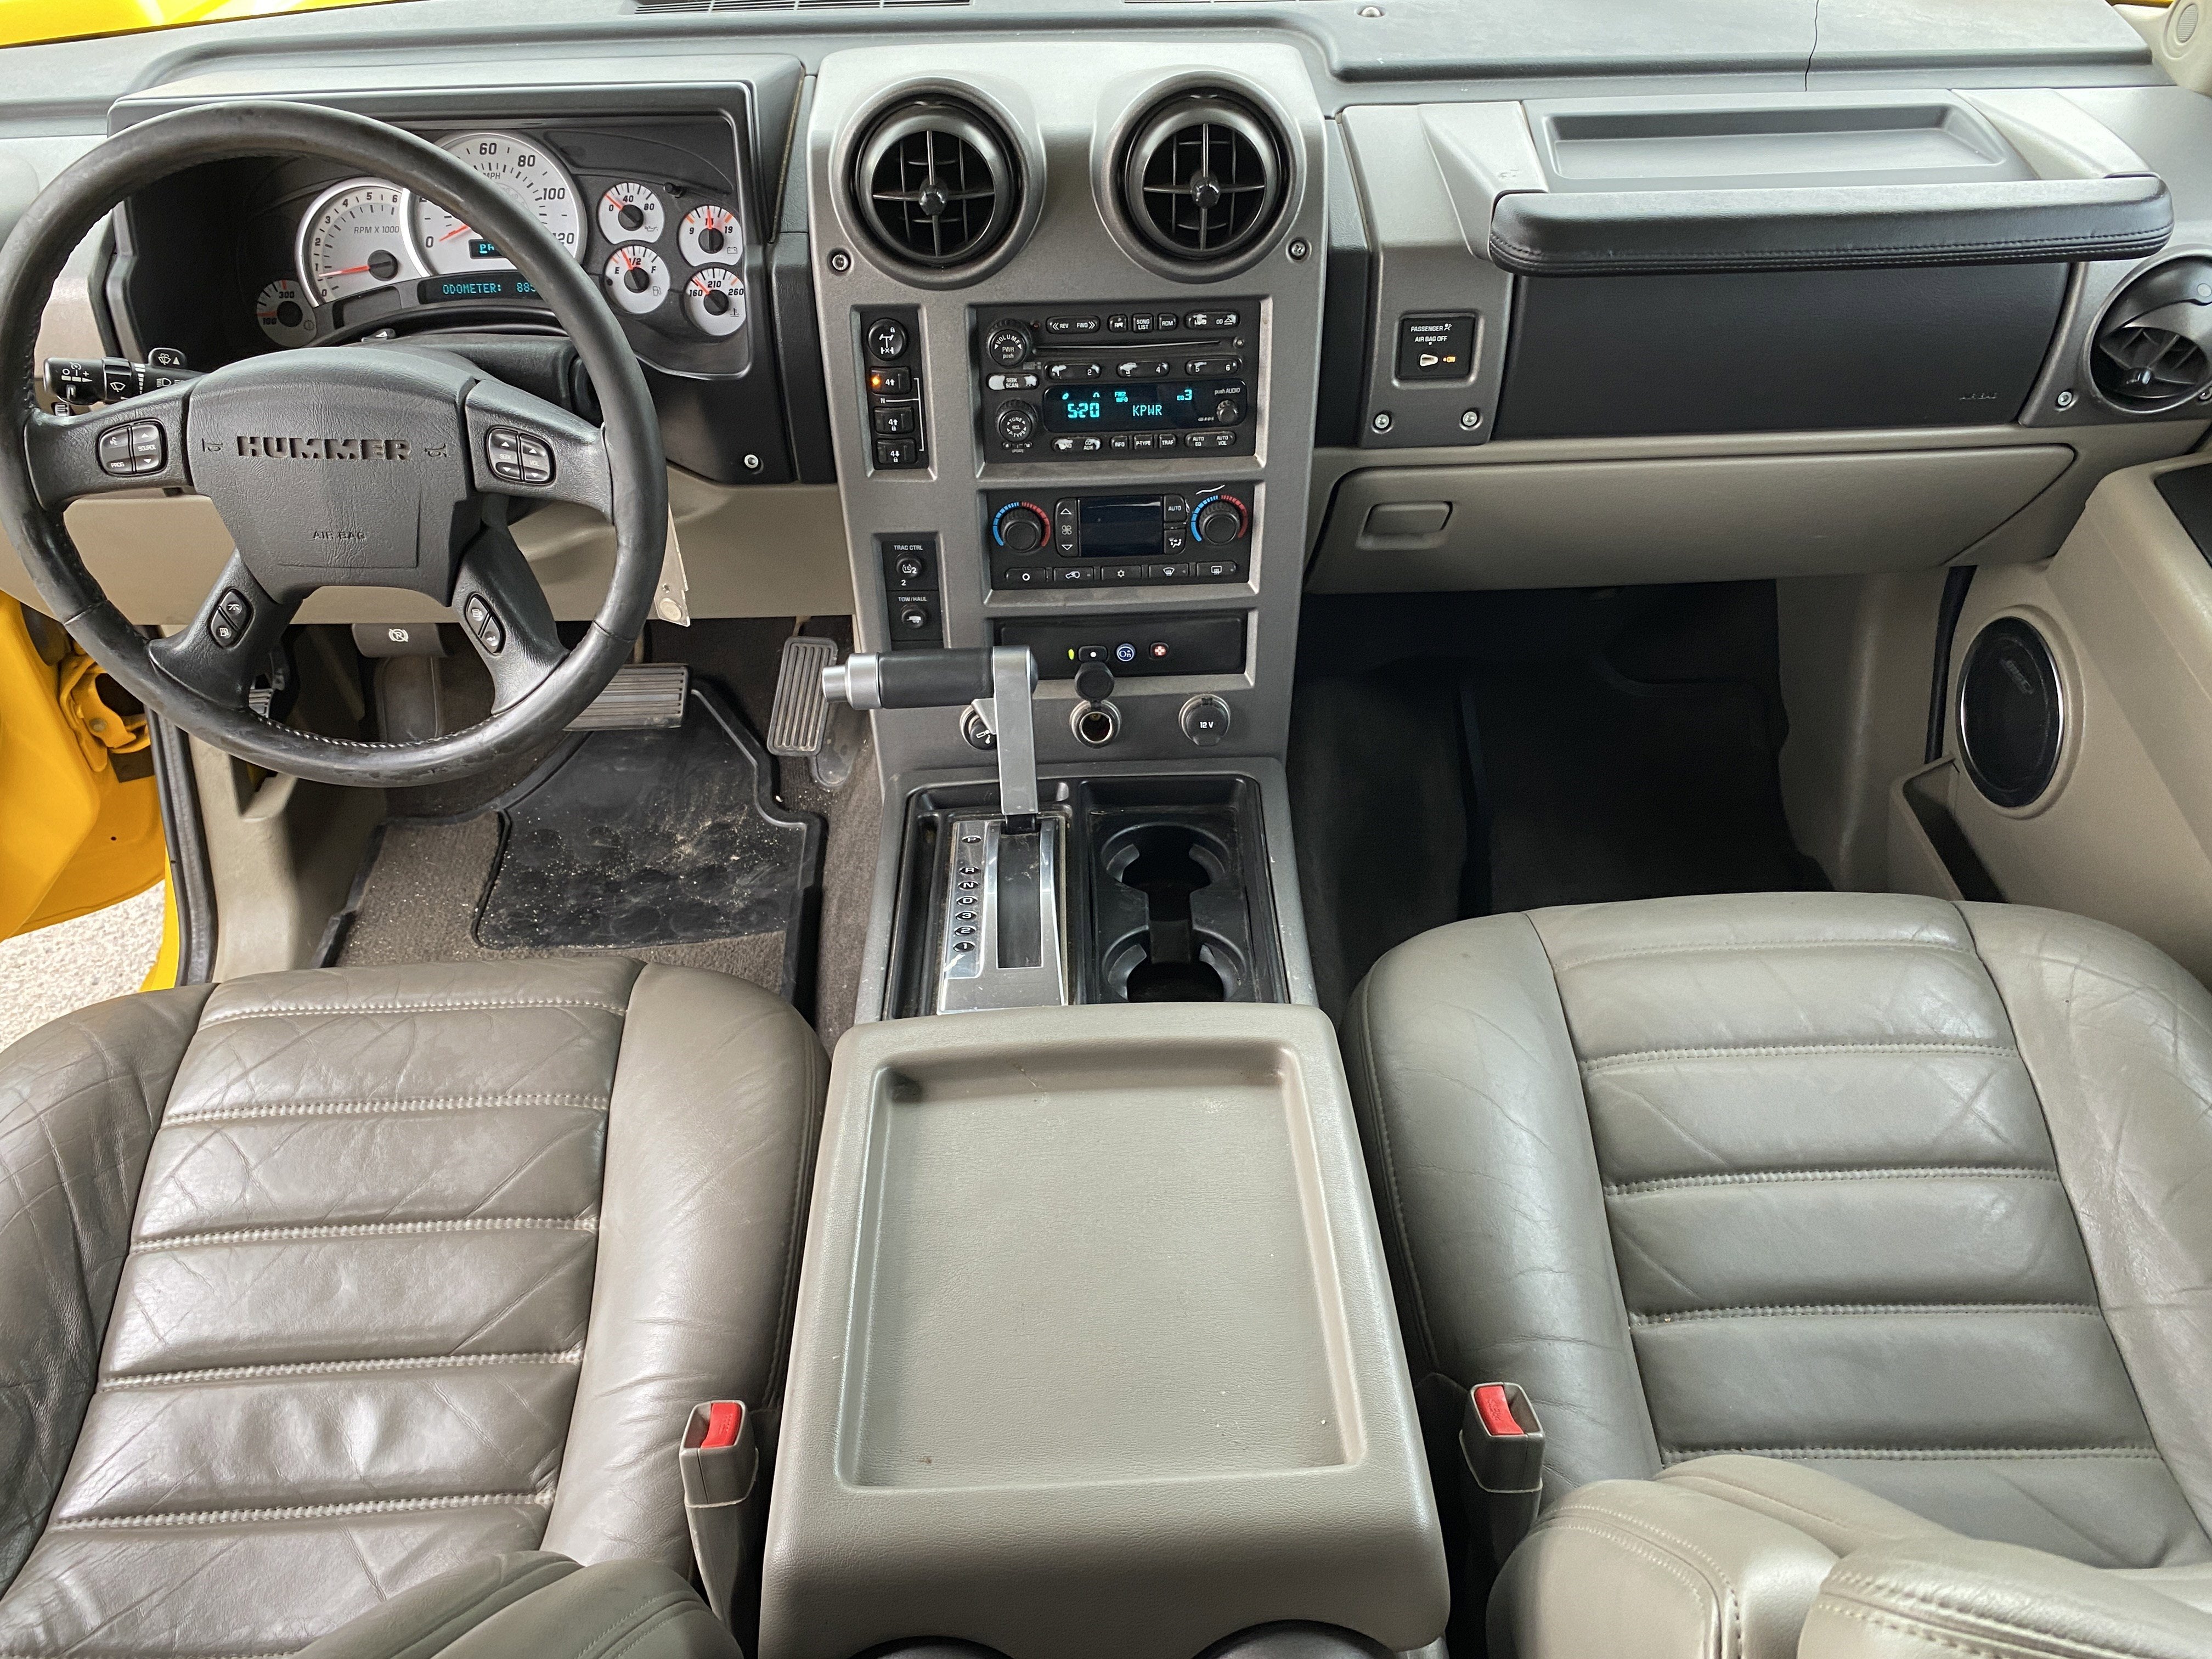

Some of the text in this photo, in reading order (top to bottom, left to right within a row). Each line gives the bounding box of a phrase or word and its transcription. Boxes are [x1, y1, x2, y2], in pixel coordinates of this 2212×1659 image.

[479, 143, 497, 155] 60
[517, 155, 535, 167] 80
[366, 192, 373, 200] 5
[392, 194, 398, 202] 6
[543, 188, 565, 200] 100
[342, 199, 349, 207] 4
[325, 216, 331, 224] 3
[314, 238, 321, 246] 2
[425, 236, 434, 247] 0
[321, 289, 328, 297] 0
[442, 283, 501, 294] ODOMETER:
[995, 334, 1020, 345] VOLUME
[1184, 389, 1192, 400] 3
[1132, 404, 1163, 416] KPWR
[237, 436, 411, 460] HUMMER
[313, 531, 334, 539] AIR
[1119, 649, 1132, 660] On
